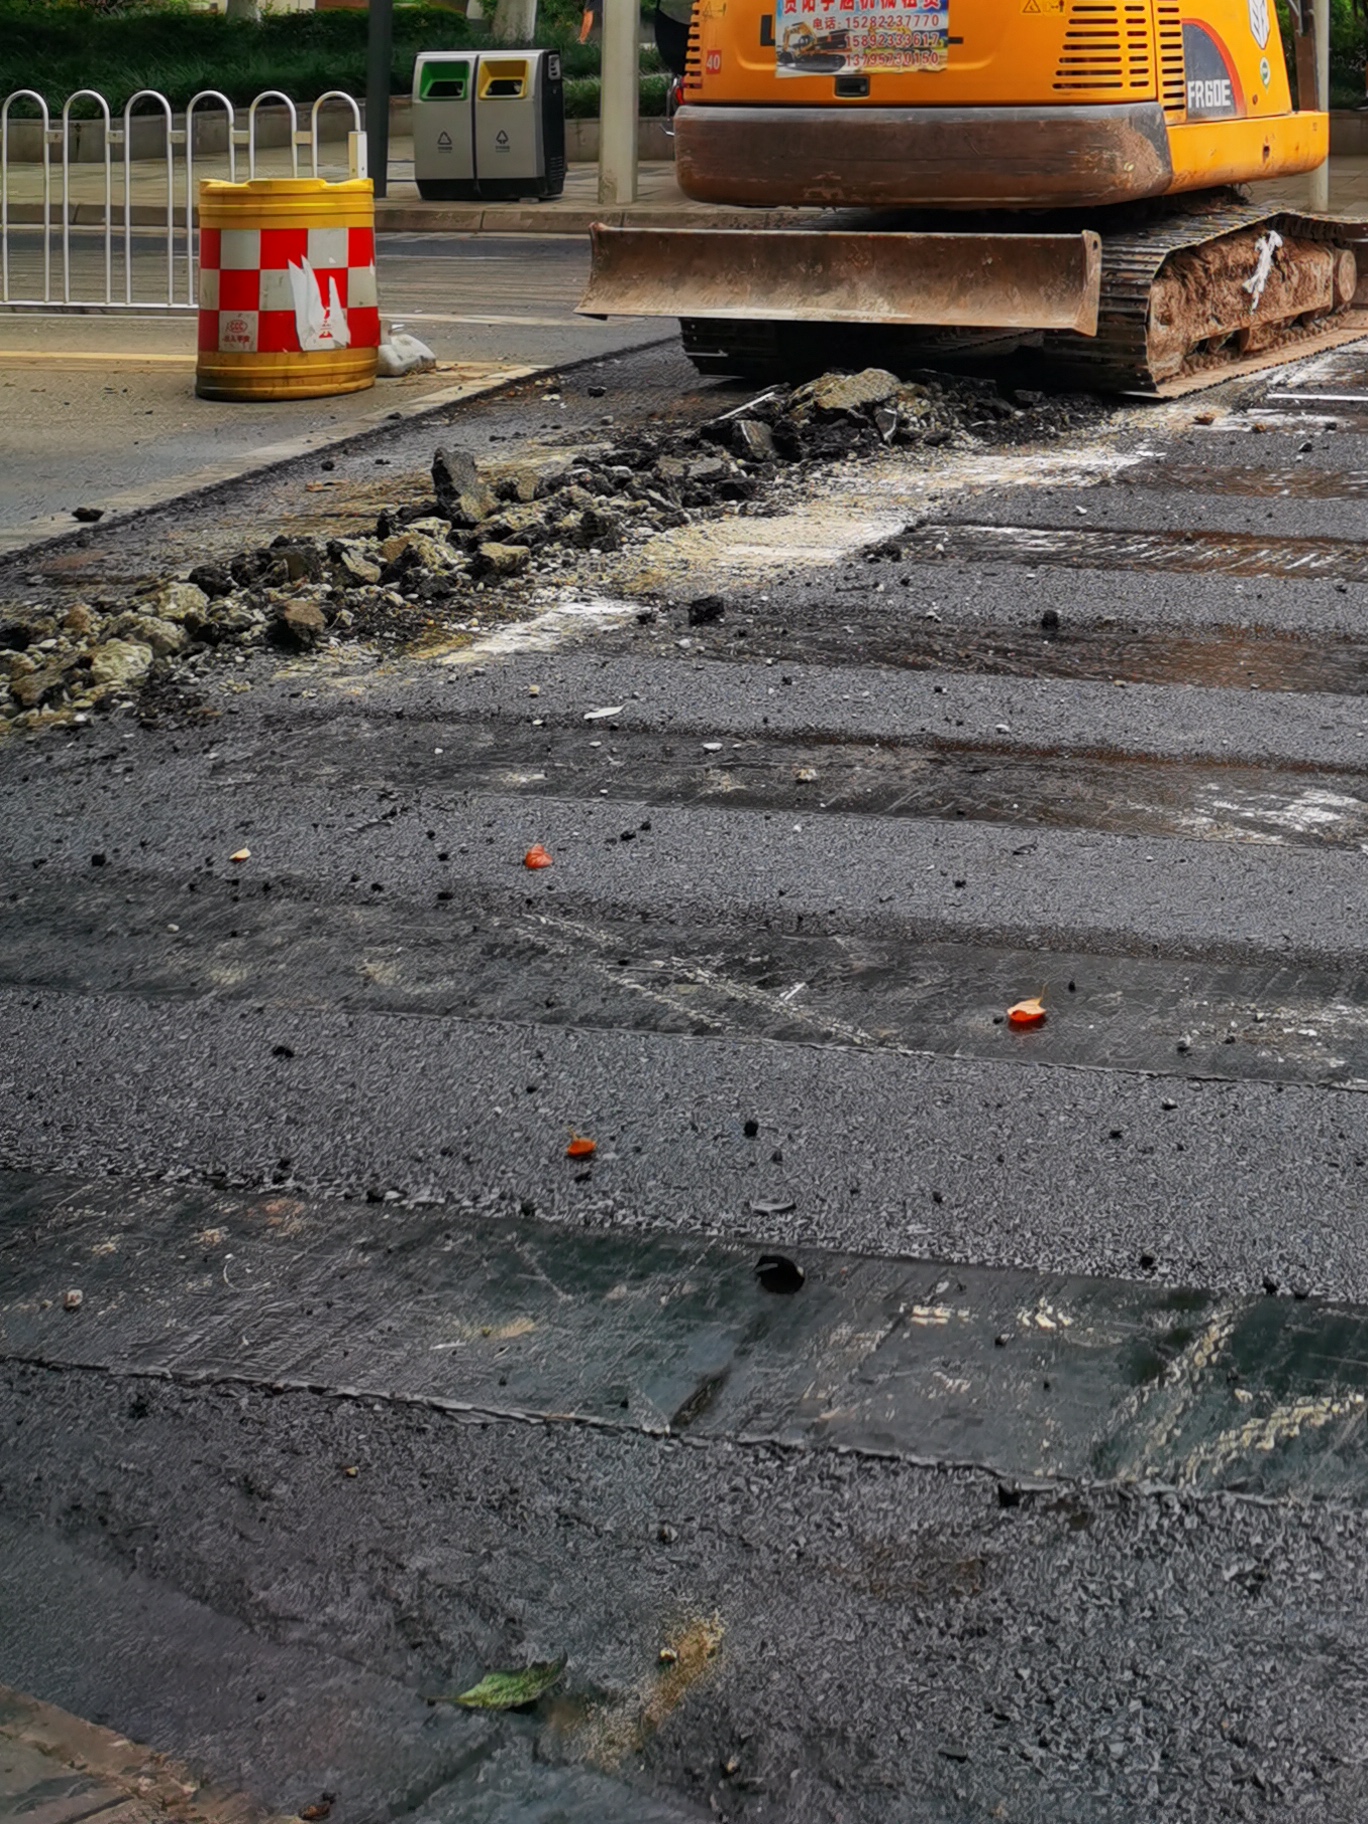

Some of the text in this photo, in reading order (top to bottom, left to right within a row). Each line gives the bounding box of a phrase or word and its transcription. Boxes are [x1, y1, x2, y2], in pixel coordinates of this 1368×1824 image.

[845, 14, 940, 29] 15282237770
[845, 33, 939, 48] 15892333617
[706, 54, 721, 70] 40
[845, 51, 940, 67] 13795730150
[1187, 78, 1231, 108] FR60E
